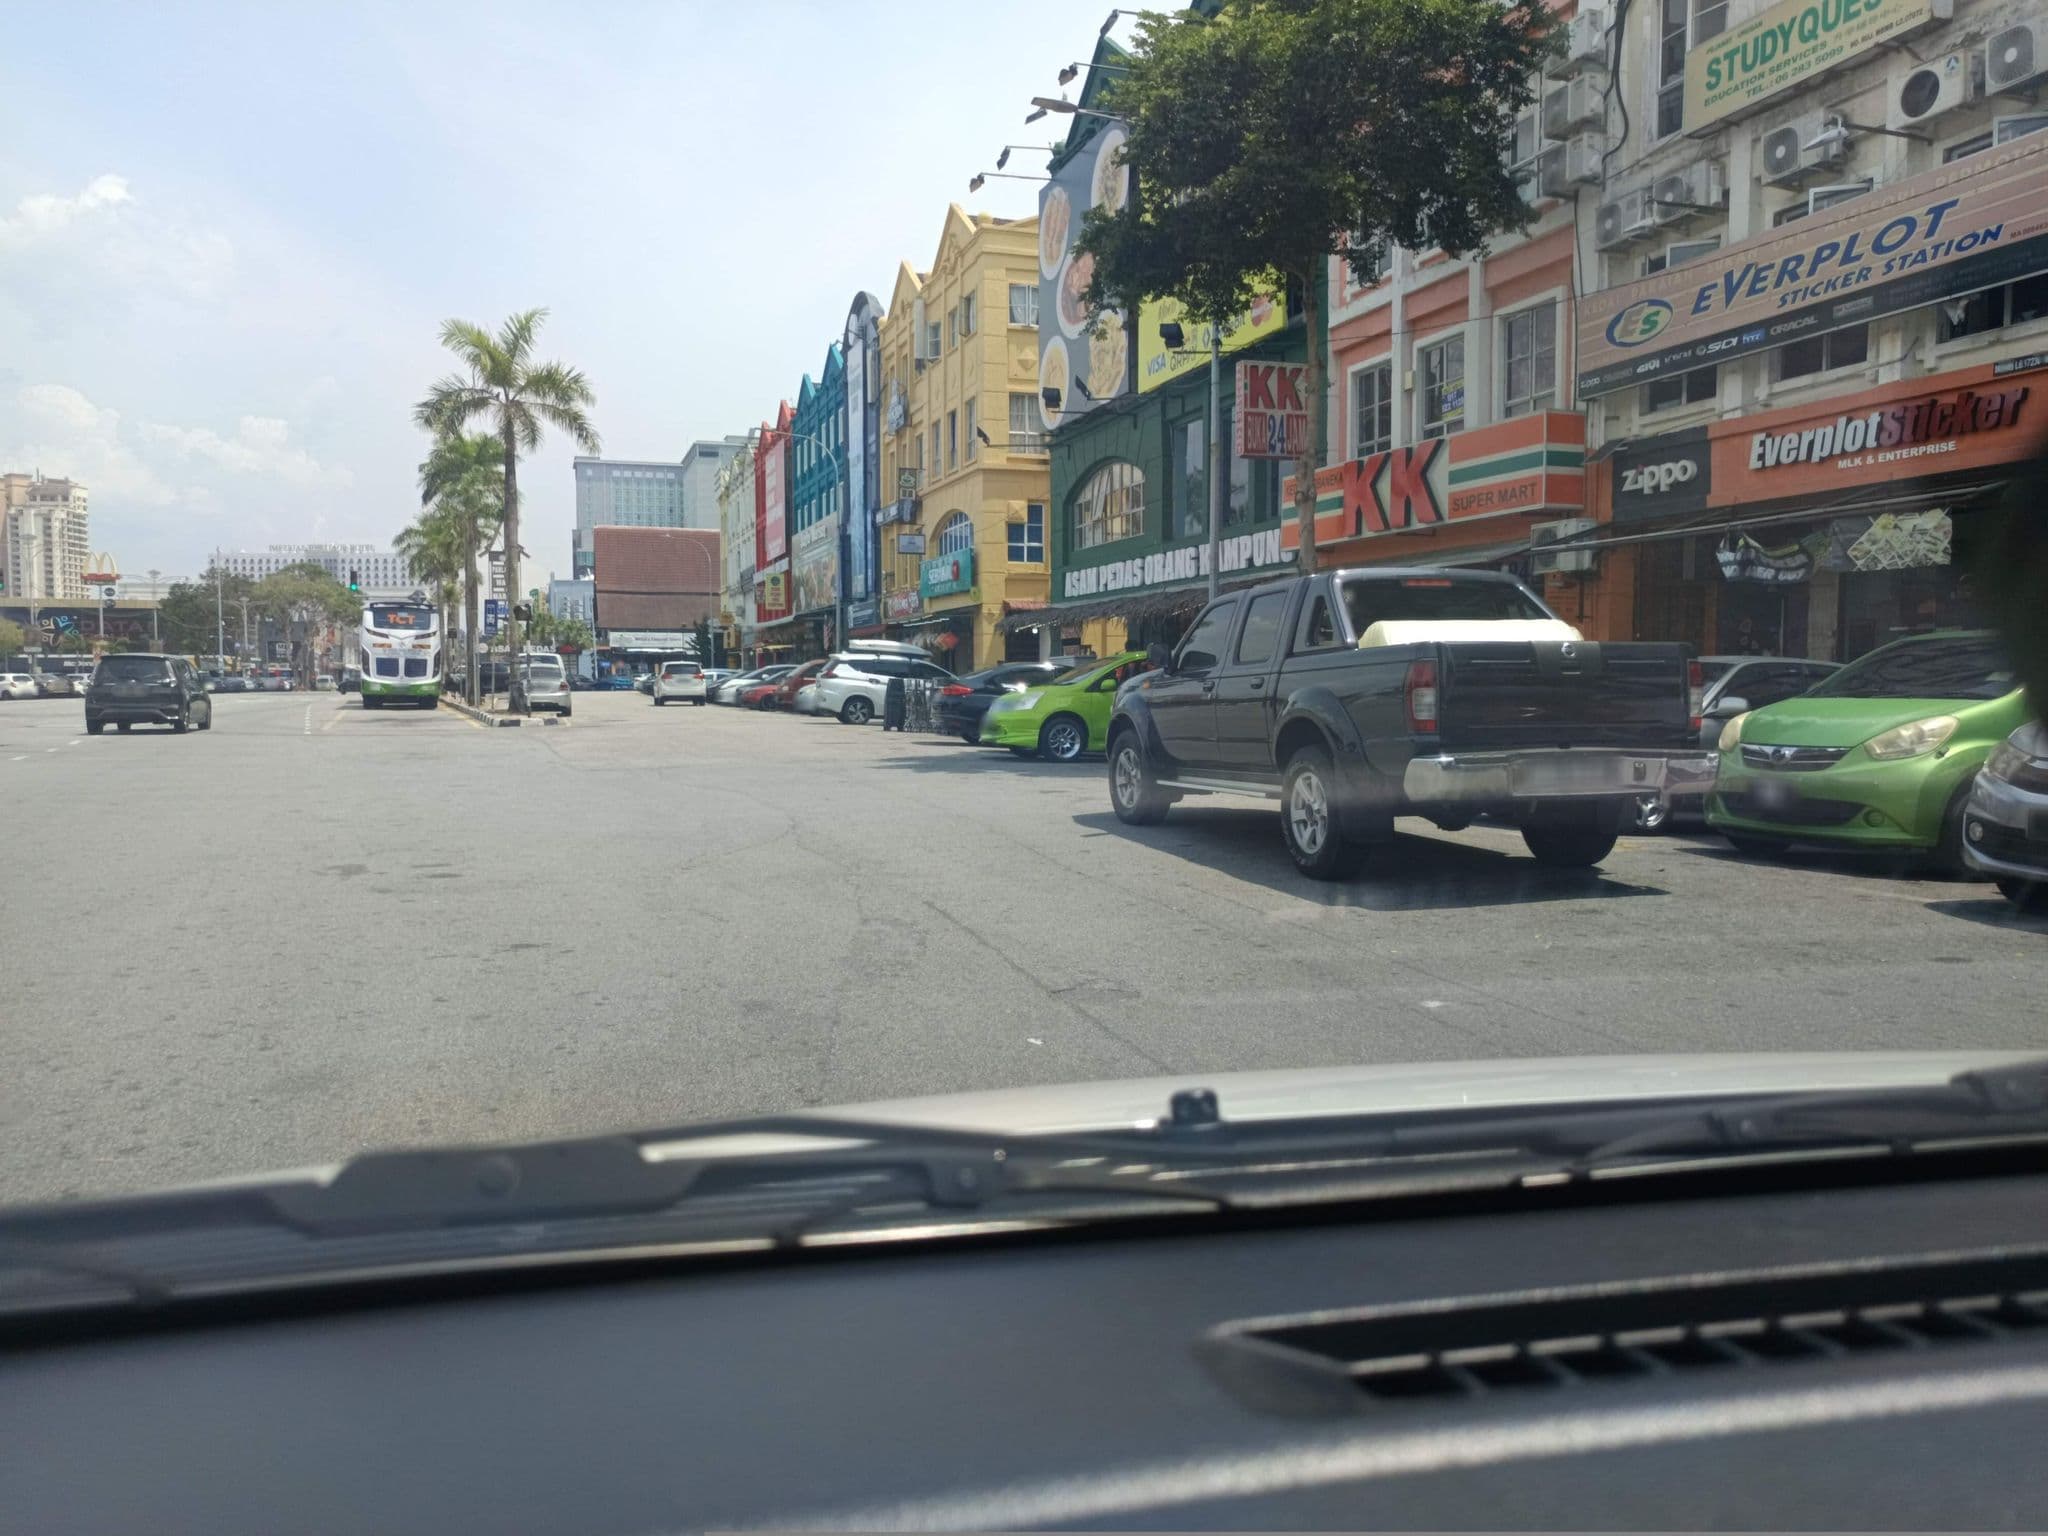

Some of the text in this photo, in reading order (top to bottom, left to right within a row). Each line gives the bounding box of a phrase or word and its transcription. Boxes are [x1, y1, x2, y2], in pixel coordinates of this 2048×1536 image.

[1703, 40, 1828, 108] EDUCATION SERVICES
[1791, 60, 1813, 79] 283
[1814, 45, 1845, 68] 5099
[1691, 197, 1960, 316] EVERPLOT
[1776, 265, 1873, 309] STICKER
[1881, 222, 2005, 277] STATION
[1146, 351, 1167, 377] VISA
[1249, 364, 1305, 411] KK
[1268, 414, 1286, 454] 24
[1837, 439, 1958, 470] MLK & ENTERPRISE
[1344, 438, 1446, 537] KK
[1452, 481, 1538, 513] SUPER MART
[1064, 566, 1099, 598] ASAM
[1099, 556, 1145, 592] PEDAS
[1144, 546, 1198, 586] ORANG
